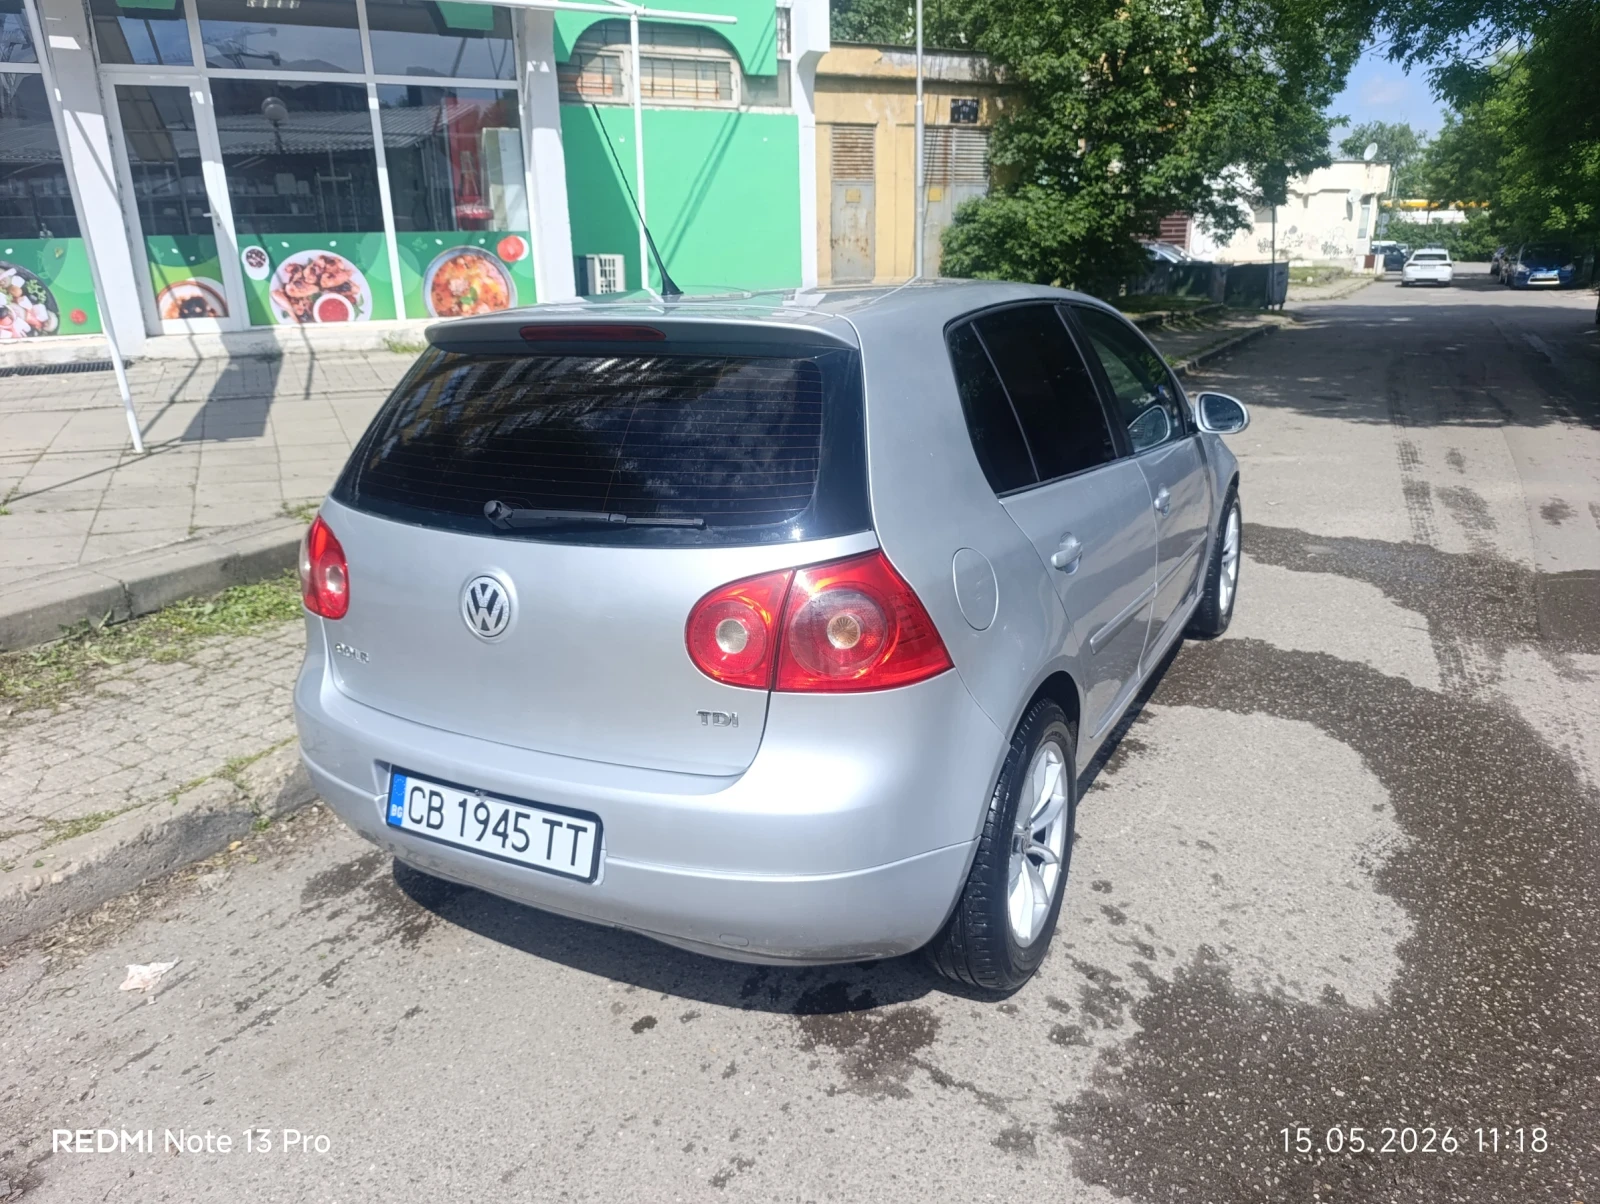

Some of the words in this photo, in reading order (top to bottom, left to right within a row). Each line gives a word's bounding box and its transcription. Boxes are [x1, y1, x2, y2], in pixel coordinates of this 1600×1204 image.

[391, 803, 404, 818] BG
[408, 786, 445, 830] CB
[458, 798, 530, 852] 1945
[542, 817, 588, 866] TT
